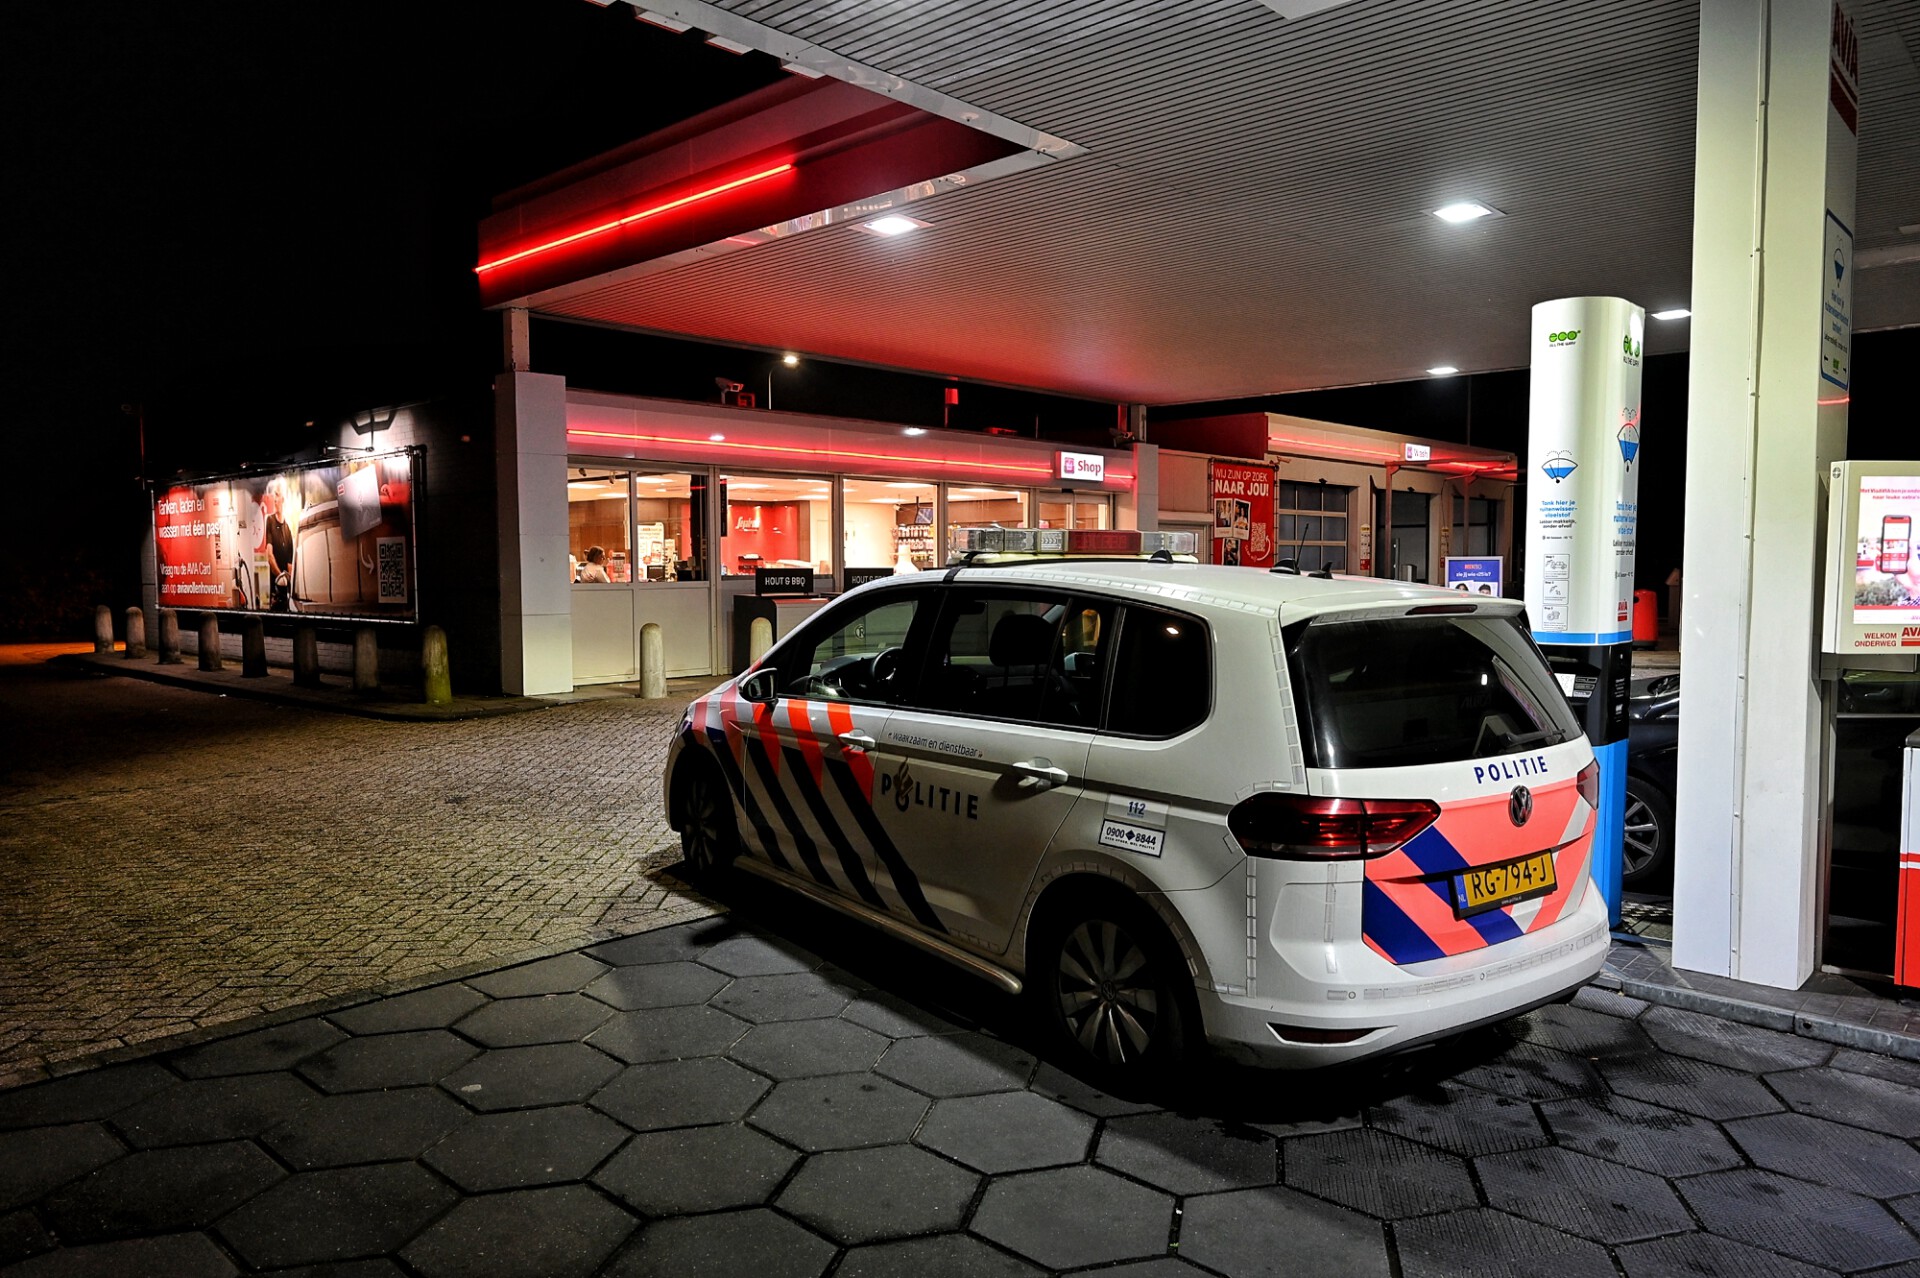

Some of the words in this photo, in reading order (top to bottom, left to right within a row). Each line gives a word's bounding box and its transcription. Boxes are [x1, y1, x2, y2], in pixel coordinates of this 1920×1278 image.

[1078, 460, 1102, 476] Shop
[1215, 468, 1227, 478] WIJ
[1228, 469, 1241, 479] ZIJN
[1242, 470, 1252, 480] OP
[1252, 471, 1268, 482] ZOEK
[1215, 480, 1244, 495] NAAR
[1247, 482, 1269, 496] JOU!
[158, 499, 179, 515] Tanken,
[180, 497, 195, 513] laden
[197, 499, 205, 511] en
[158, 525, 179, 538] wassen
[180, 521, 192, 537] met
[193, 520, 205, 536] één
[160, 563, 174, 578] Vraag
[174, 566, 180, 575] nu
[180, 563, 187, 575] de
[199, 562, 211, 575] Card
[161, 584, 170, 594] aan
[170, 584, 176, 595] op
[177, 581, 225, 594] aviavollenhoven.nl
[765, 576, 784, 585] HOUT
[785, 577, 791, 585] &
[791, 577, 806, 587] BBQ
[852, 576, 868, 584] HOUT
[893, 732, 927, 746] waakzaam
[928, 739, 938, 749] en
[938, 740, 977, 757] dienstbaar
[1473, 756, 1548, 784] POLITIE
[881, 773, 979, 820] POLITIE
[1129, 801, 1146, 815] 112
[1106, 827, 1125, 839] 0900
[1135, 832, 1157, 846] 8844
[1471, 856, 1547, 899] RG-794-J
[1457, 893, 1466, 903] NL
